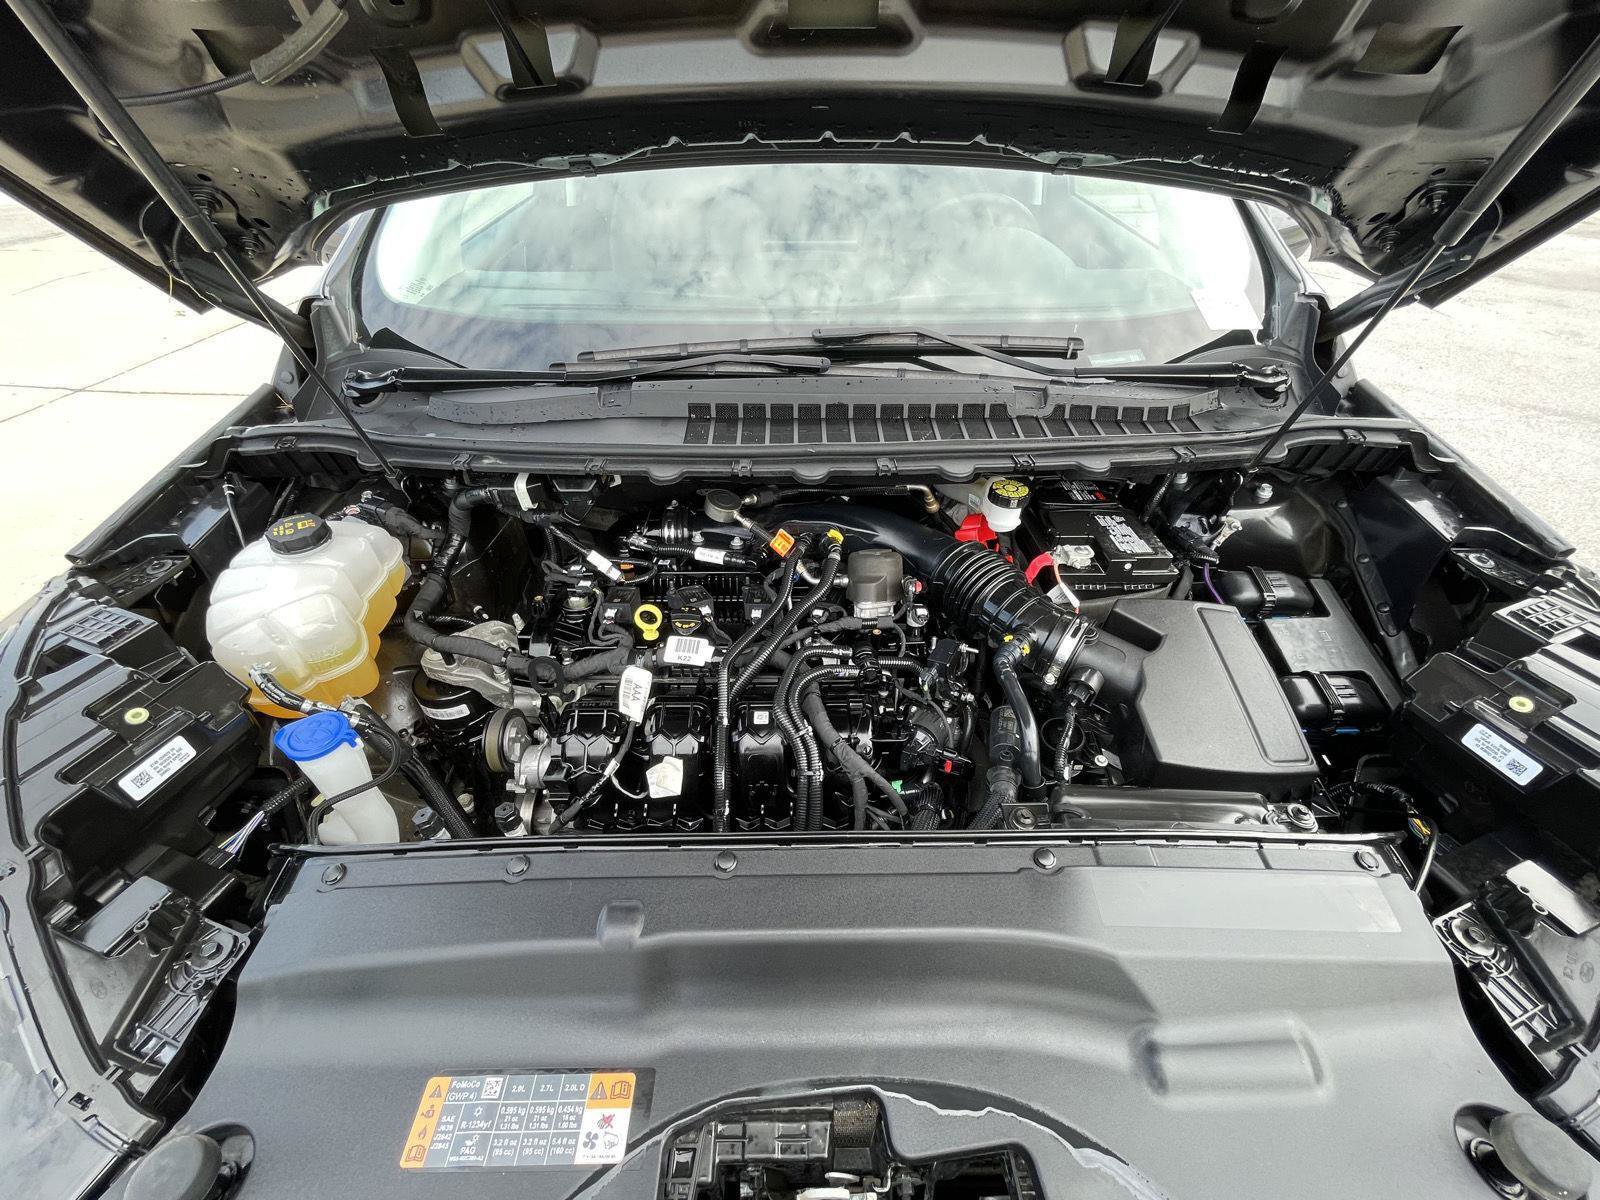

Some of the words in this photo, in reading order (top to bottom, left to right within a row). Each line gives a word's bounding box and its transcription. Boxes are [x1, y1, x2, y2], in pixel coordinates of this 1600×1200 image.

[451, 1080, 481, 1089] FoMoCo
[540, 1083, 554, 1092] 2.7L
[564, 1083, 579, 1092] 2.0L
[517, 1106, 527, 1116] kg
[546, 1106, 555, 1116] kg
[575, 1105, 584, 1116] kg
[460, 1120, 493, 1130] R-1234yf
[459, 1146, 476, 1155] PAG
